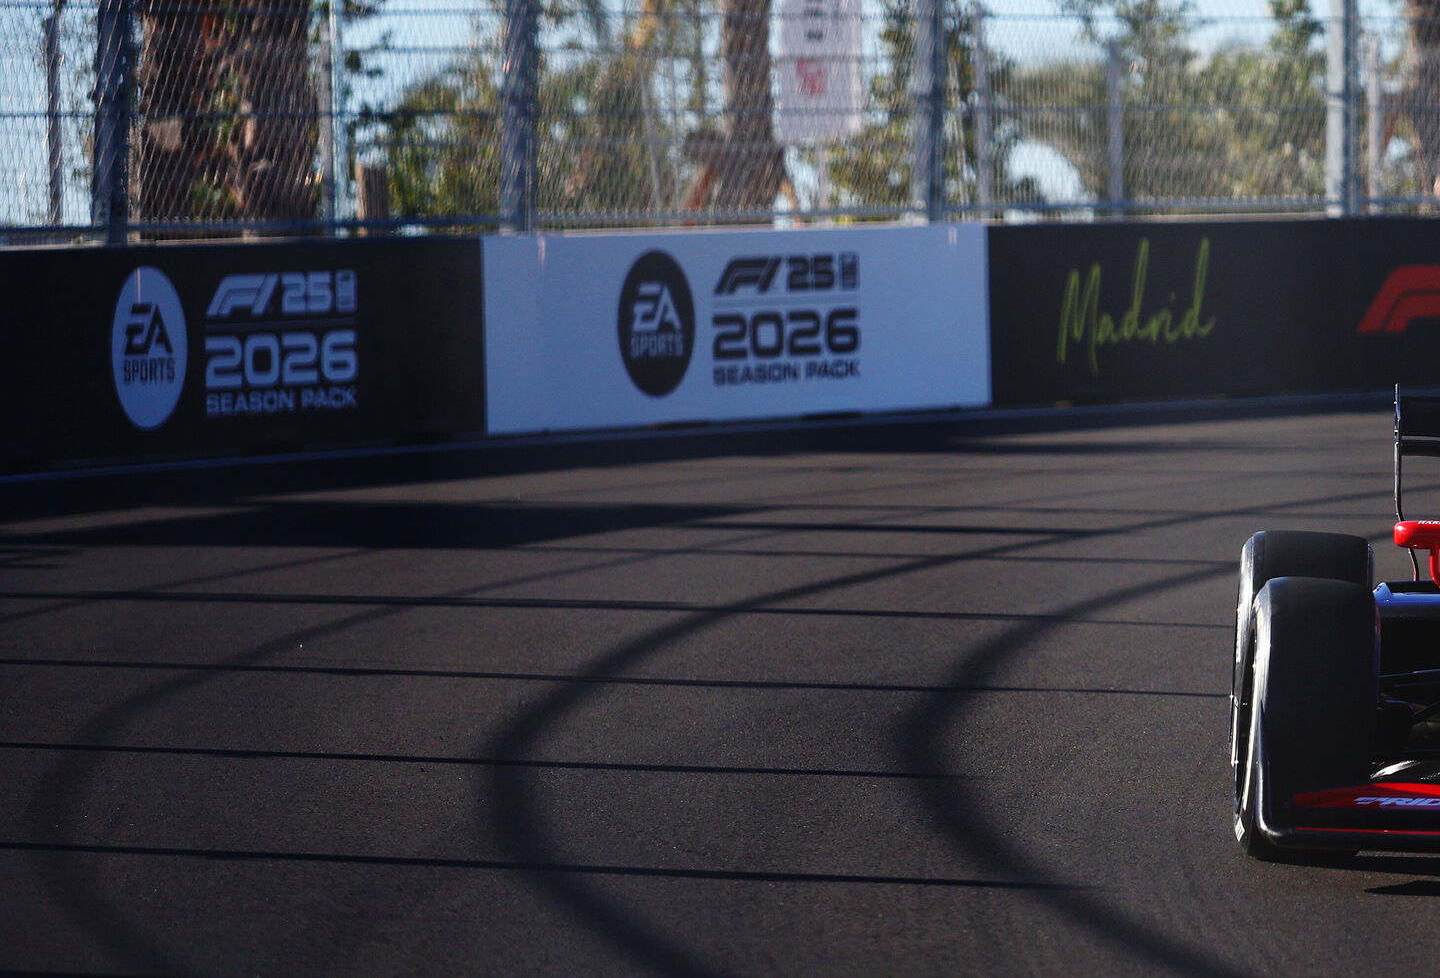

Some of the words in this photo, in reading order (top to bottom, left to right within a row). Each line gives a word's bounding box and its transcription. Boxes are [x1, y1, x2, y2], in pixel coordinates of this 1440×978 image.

[123, 302, 173, 356] EA
[632, 280, 682, 332] EA
[1057, 237, 1216, 373] Madrid
[204, 328, 359, 389] 2026
[630, 331, 684, 360] SPORTS
[712, 307, 860, 361] 2026
[122, 357, 176, 386] SPORTS
[712, 362, 799, 388] SEASON
[804, 358, 861, 381] PACK
[205, 388, 296, 418] SEASON
[299, 384, 359, 410] PACK
